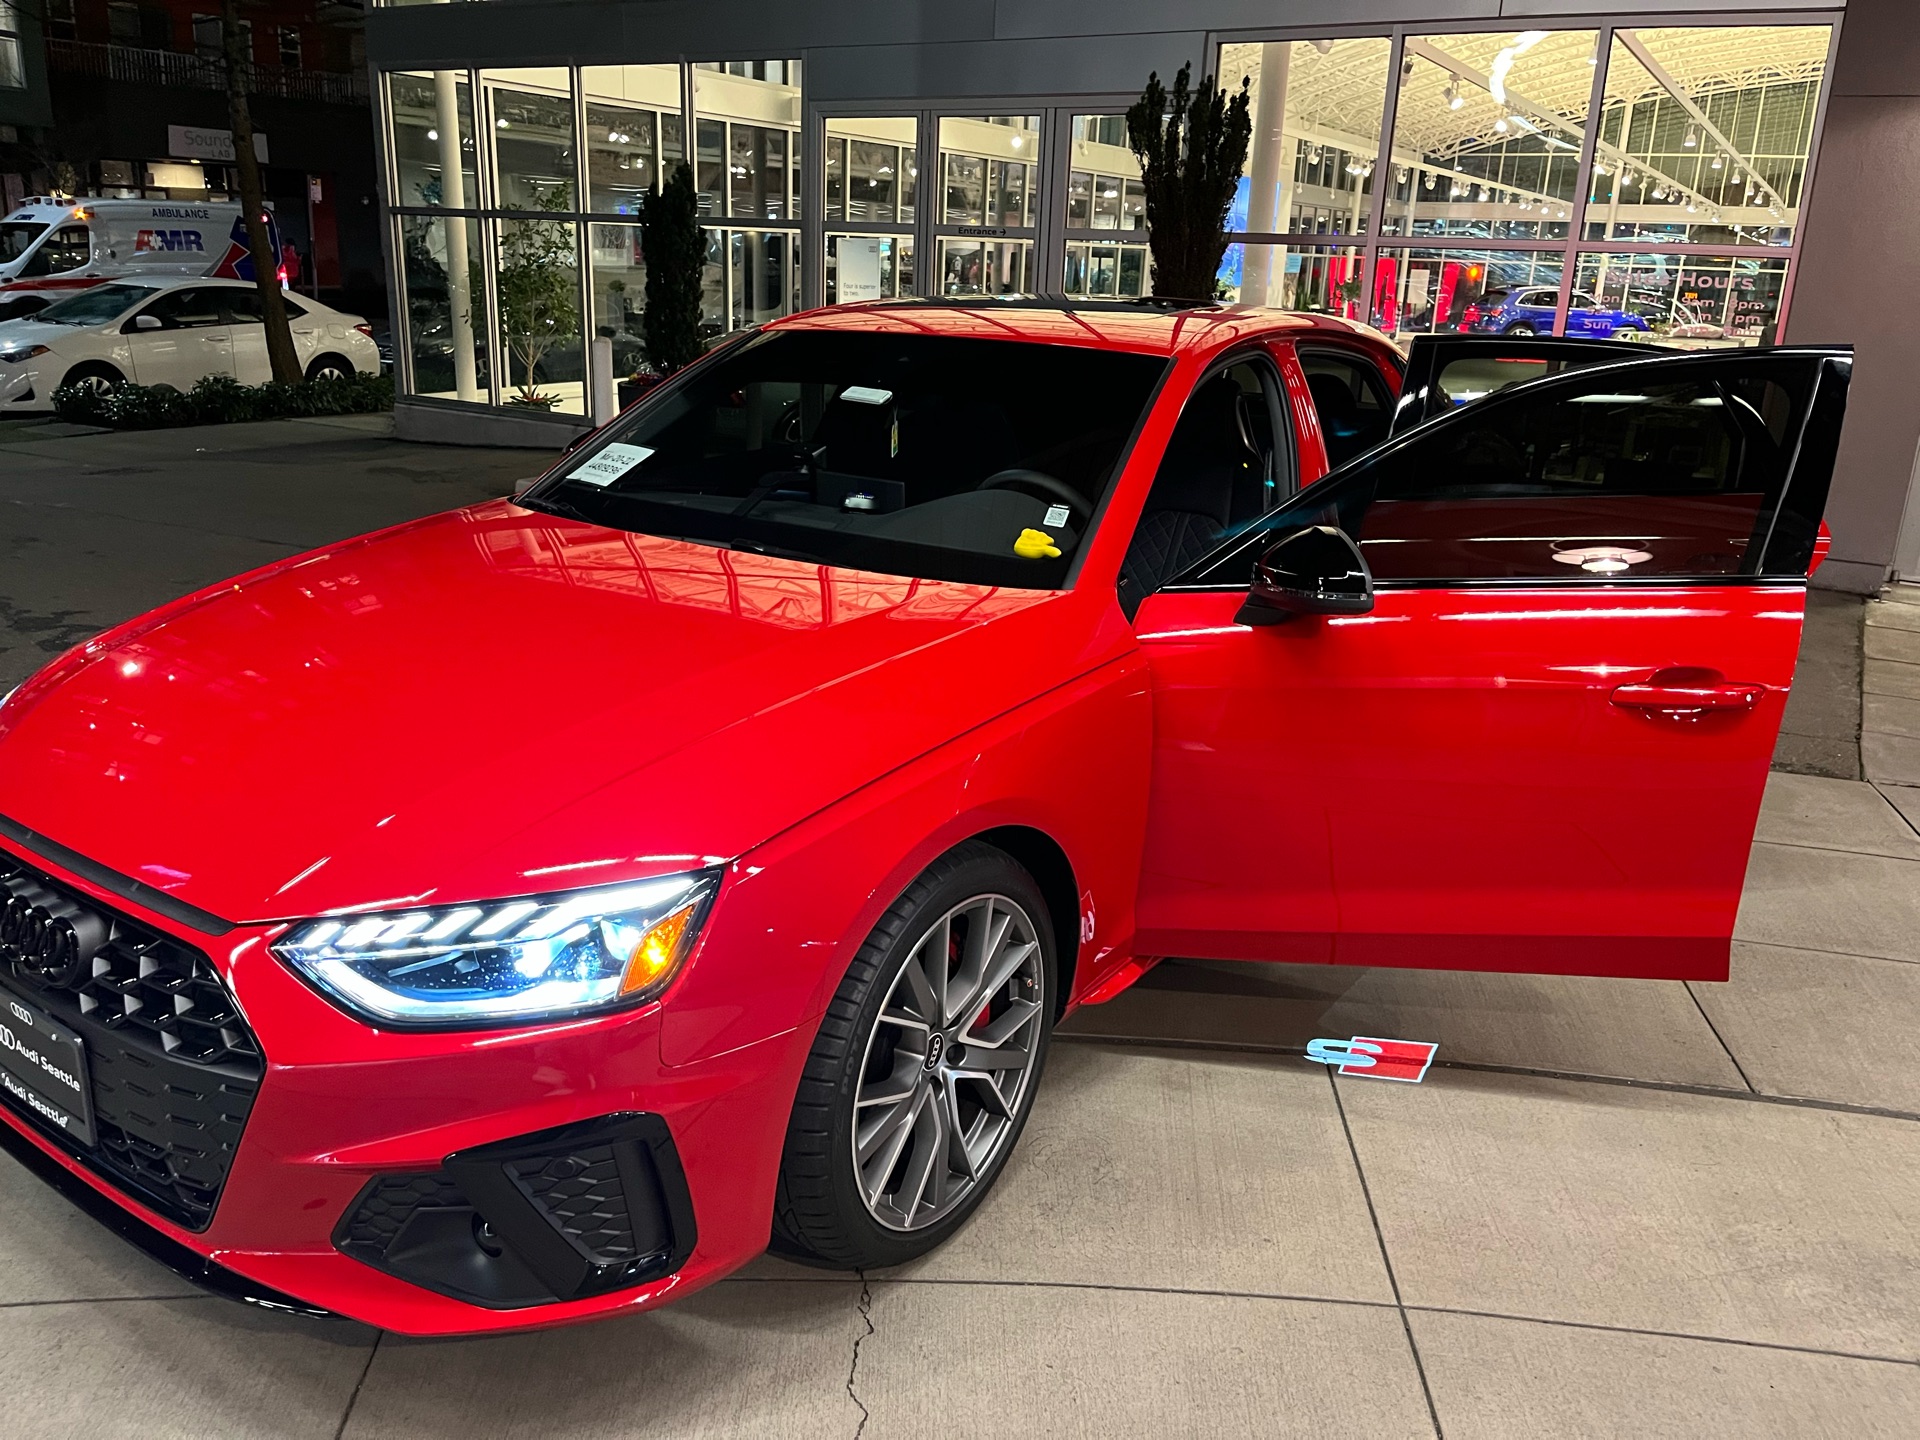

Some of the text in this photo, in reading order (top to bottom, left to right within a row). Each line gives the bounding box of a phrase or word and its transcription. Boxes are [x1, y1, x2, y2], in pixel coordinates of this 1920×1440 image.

[183, 130, 232, 149] Sound
[211, 149, 231, 159] LAB
[152, 208, 210, 219] AMBULANCE
[135, 229, 205, 252] AMR
[958, 226, 998, 236] Entrance
[1604, 267, 1756, 290] Sales Hours
[1681, 296, 1715, 308] 9am
[16, 1040, 80, 1092] Audi Seattle
[4, 1076, 68, 1128] Audi Seattle
